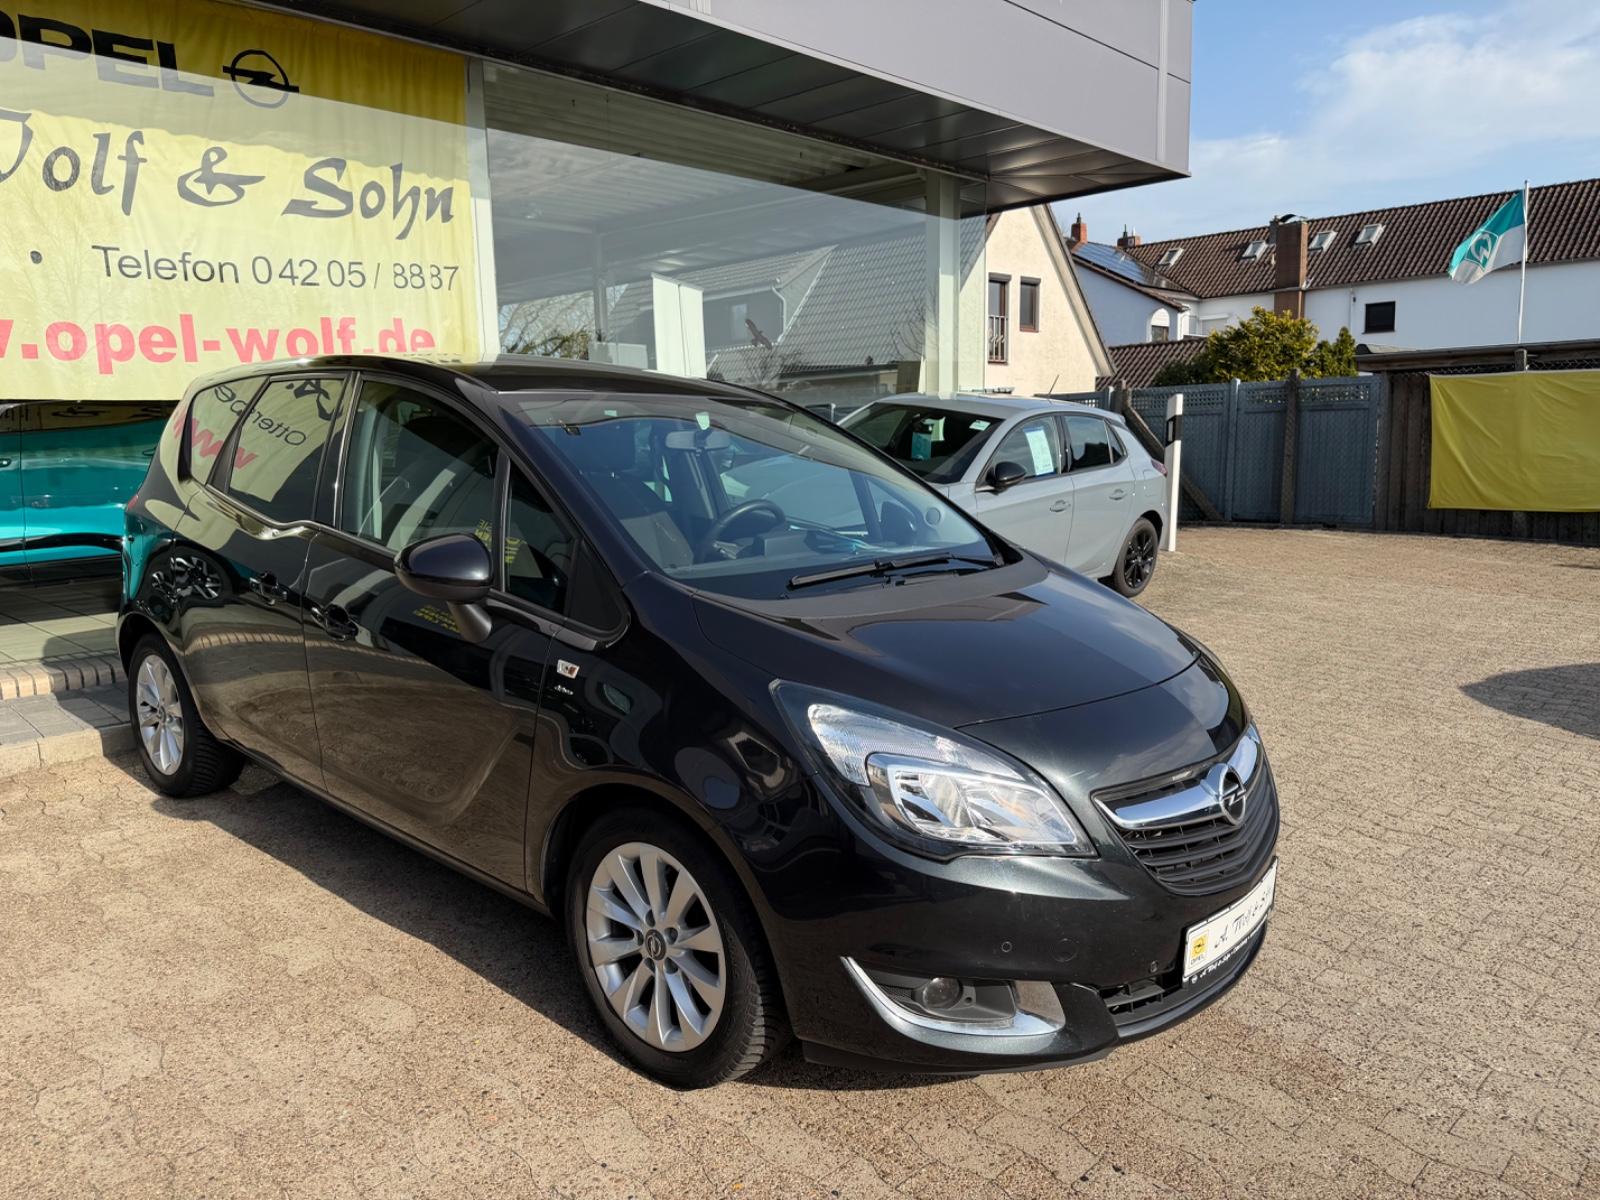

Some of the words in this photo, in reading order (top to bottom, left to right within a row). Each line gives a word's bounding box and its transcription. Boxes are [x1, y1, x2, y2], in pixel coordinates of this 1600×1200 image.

[0, 10, 214, 97] PEL
[177, 146, 266, 207] &
[281, 158, 454, 240] Sohn
[91, 245, 239, 284] Telefon
[0, 313, 436, 375] .opel-wolf.de
